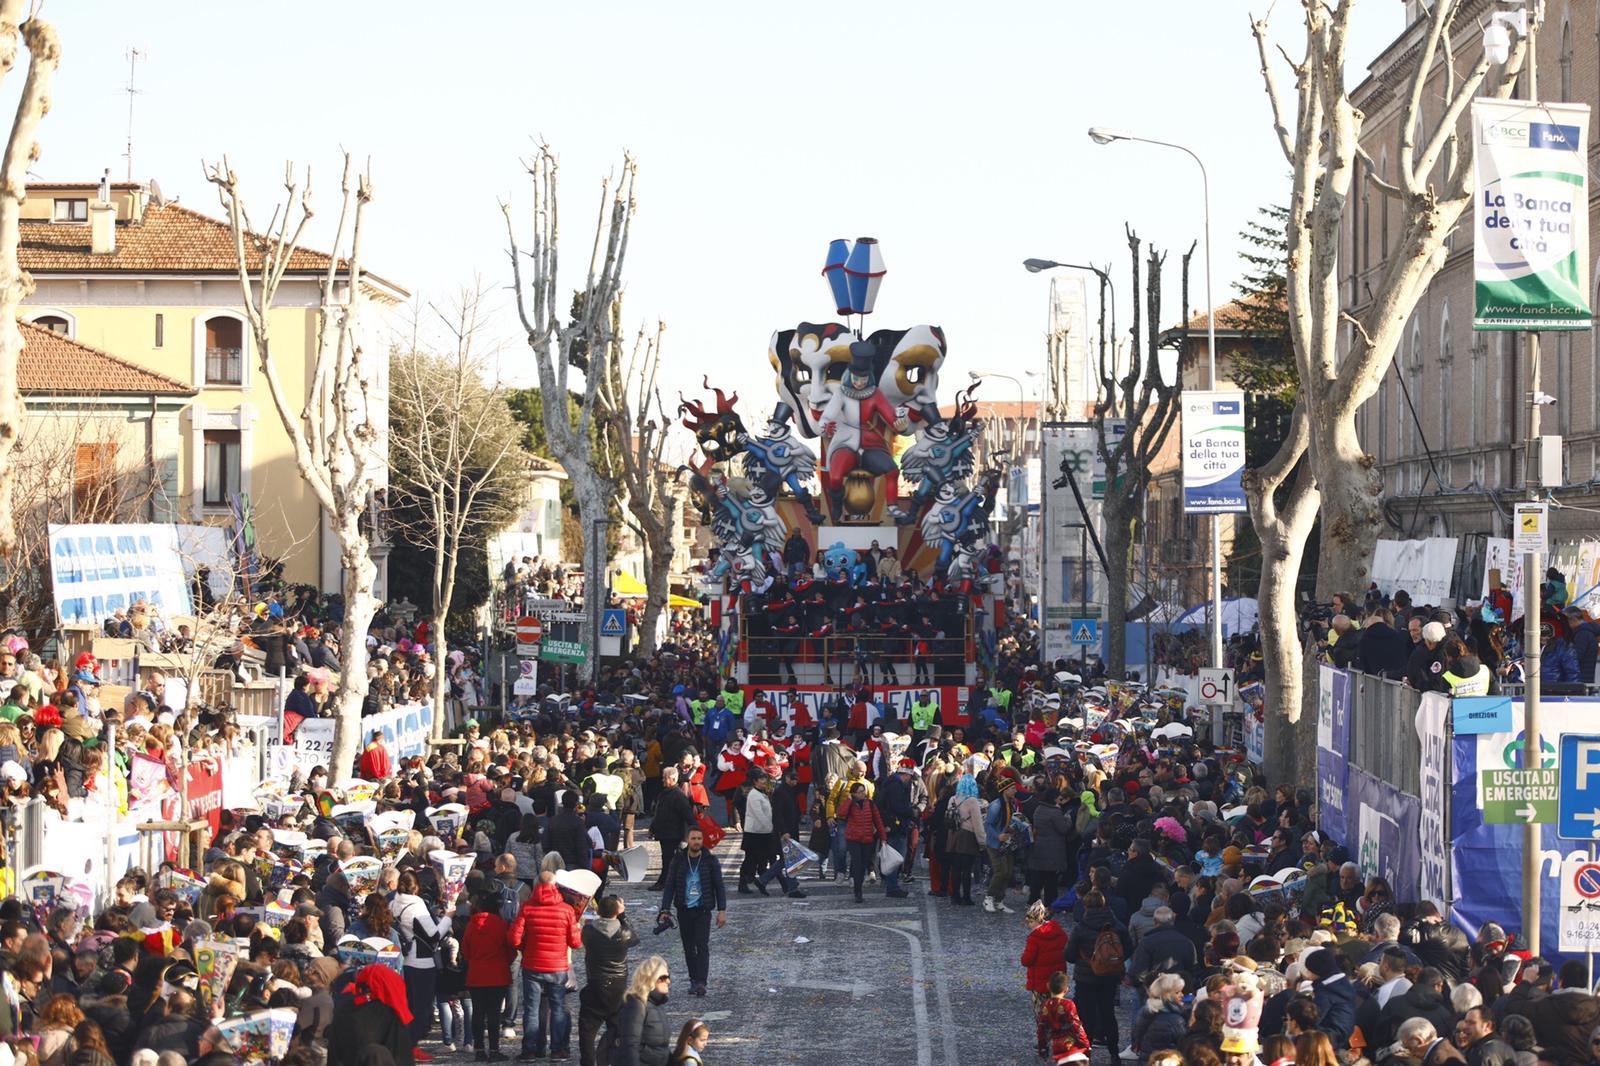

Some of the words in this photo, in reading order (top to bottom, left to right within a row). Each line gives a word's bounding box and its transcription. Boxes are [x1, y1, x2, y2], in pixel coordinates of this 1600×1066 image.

[1542, 131, 1566, 143] Fano
[1484, 189, 1506, 208] La
[1513, 192, 1572, 213] Banca
[1539, 217, 1570, 234] tua
[1190, 439, 1202, 448] La
[1206, 439, 1239, 448] Banca
[1190, 449, 1217, 459] della
[1221, 451, 1239, 459] tua
[543, 645, 585, 657] EMERGENZA
[548, 640, 573, 649] USCITA
[574, 642, 582, 651] DI
[889, 690, 940, 718] FAO
[1468, 711, 1498, 719] DIREZIONE
[1493, 770, 1540, 786] USCITA
[1542, 770, 1555, 785] DI
